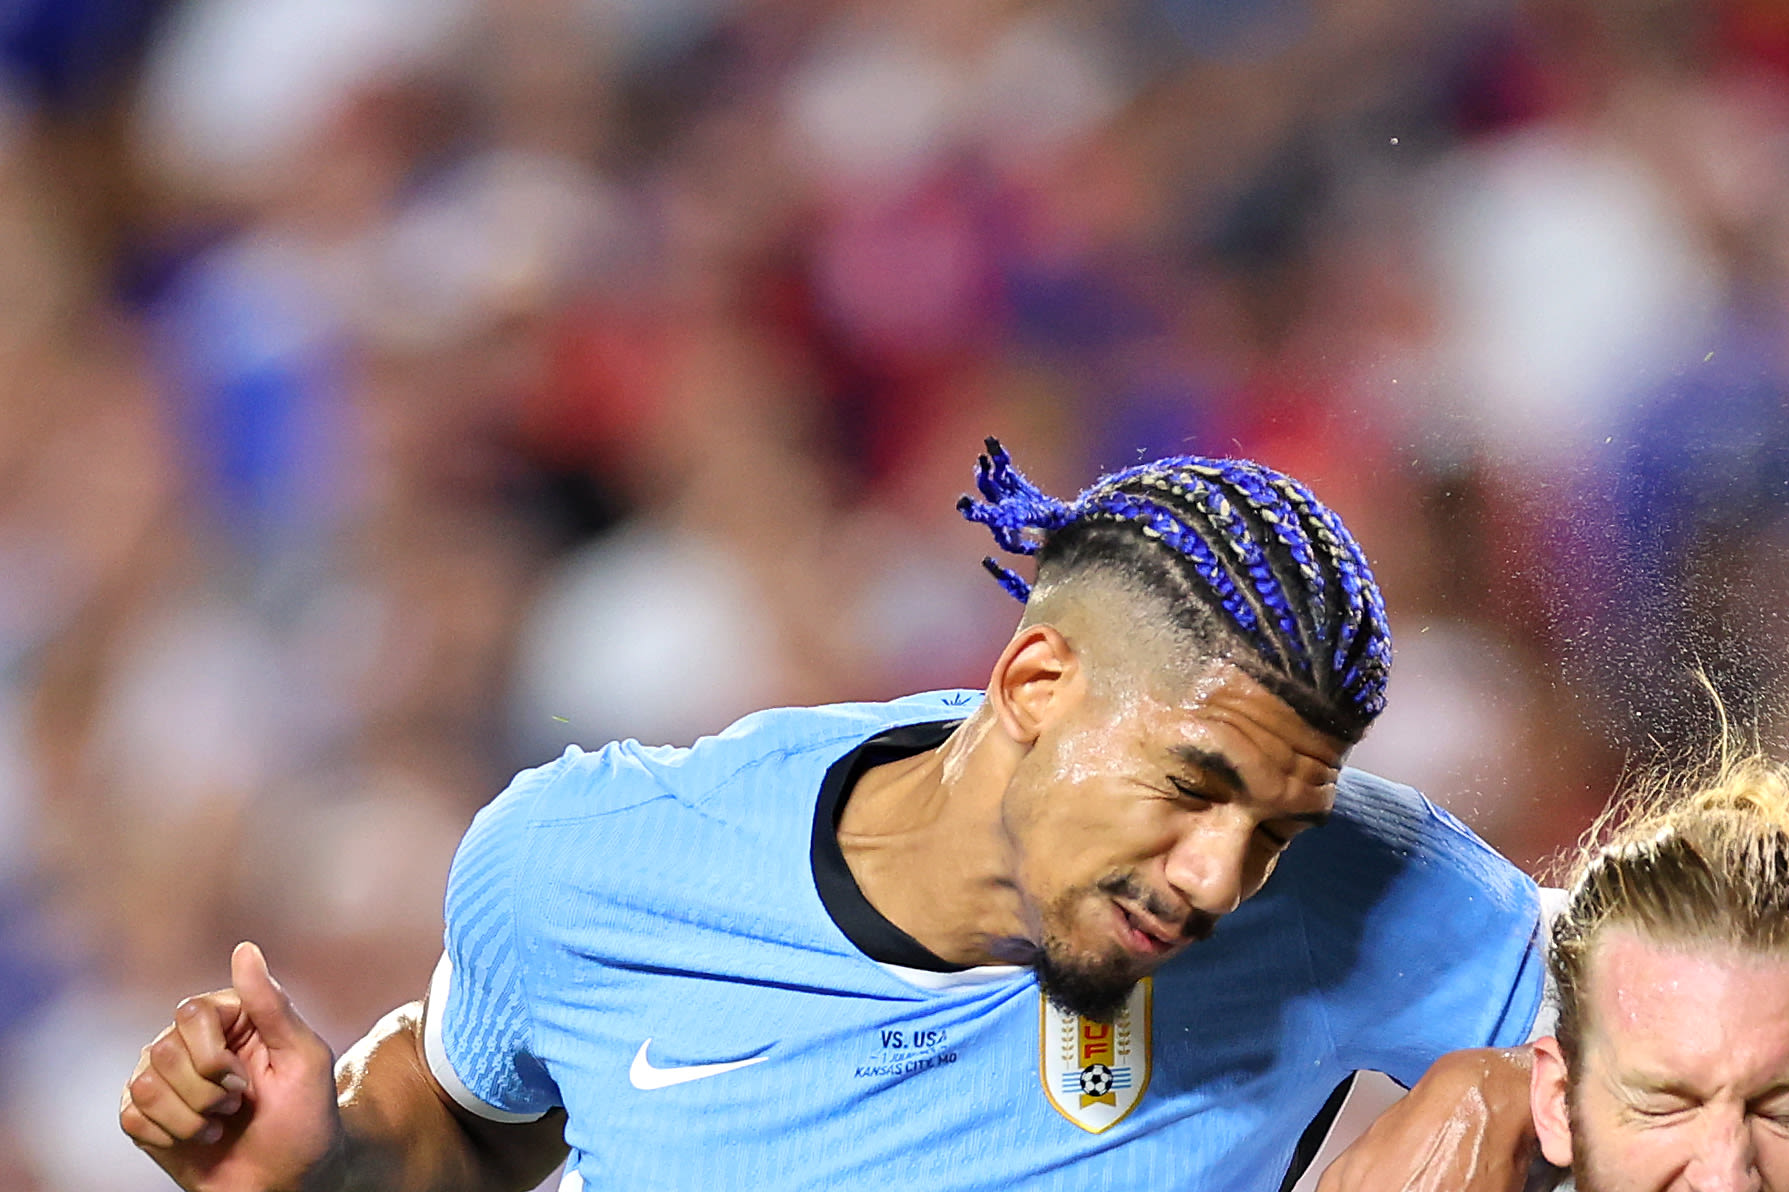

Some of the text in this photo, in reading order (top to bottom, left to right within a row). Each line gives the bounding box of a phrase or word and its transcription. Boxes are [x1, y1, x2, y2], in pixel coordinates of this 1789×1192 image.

[881, 1030, 948, 1049] VS. USA
[854, 1062, 902, 1078] KANSAS
[938, 1052, 957, 1066] MO
